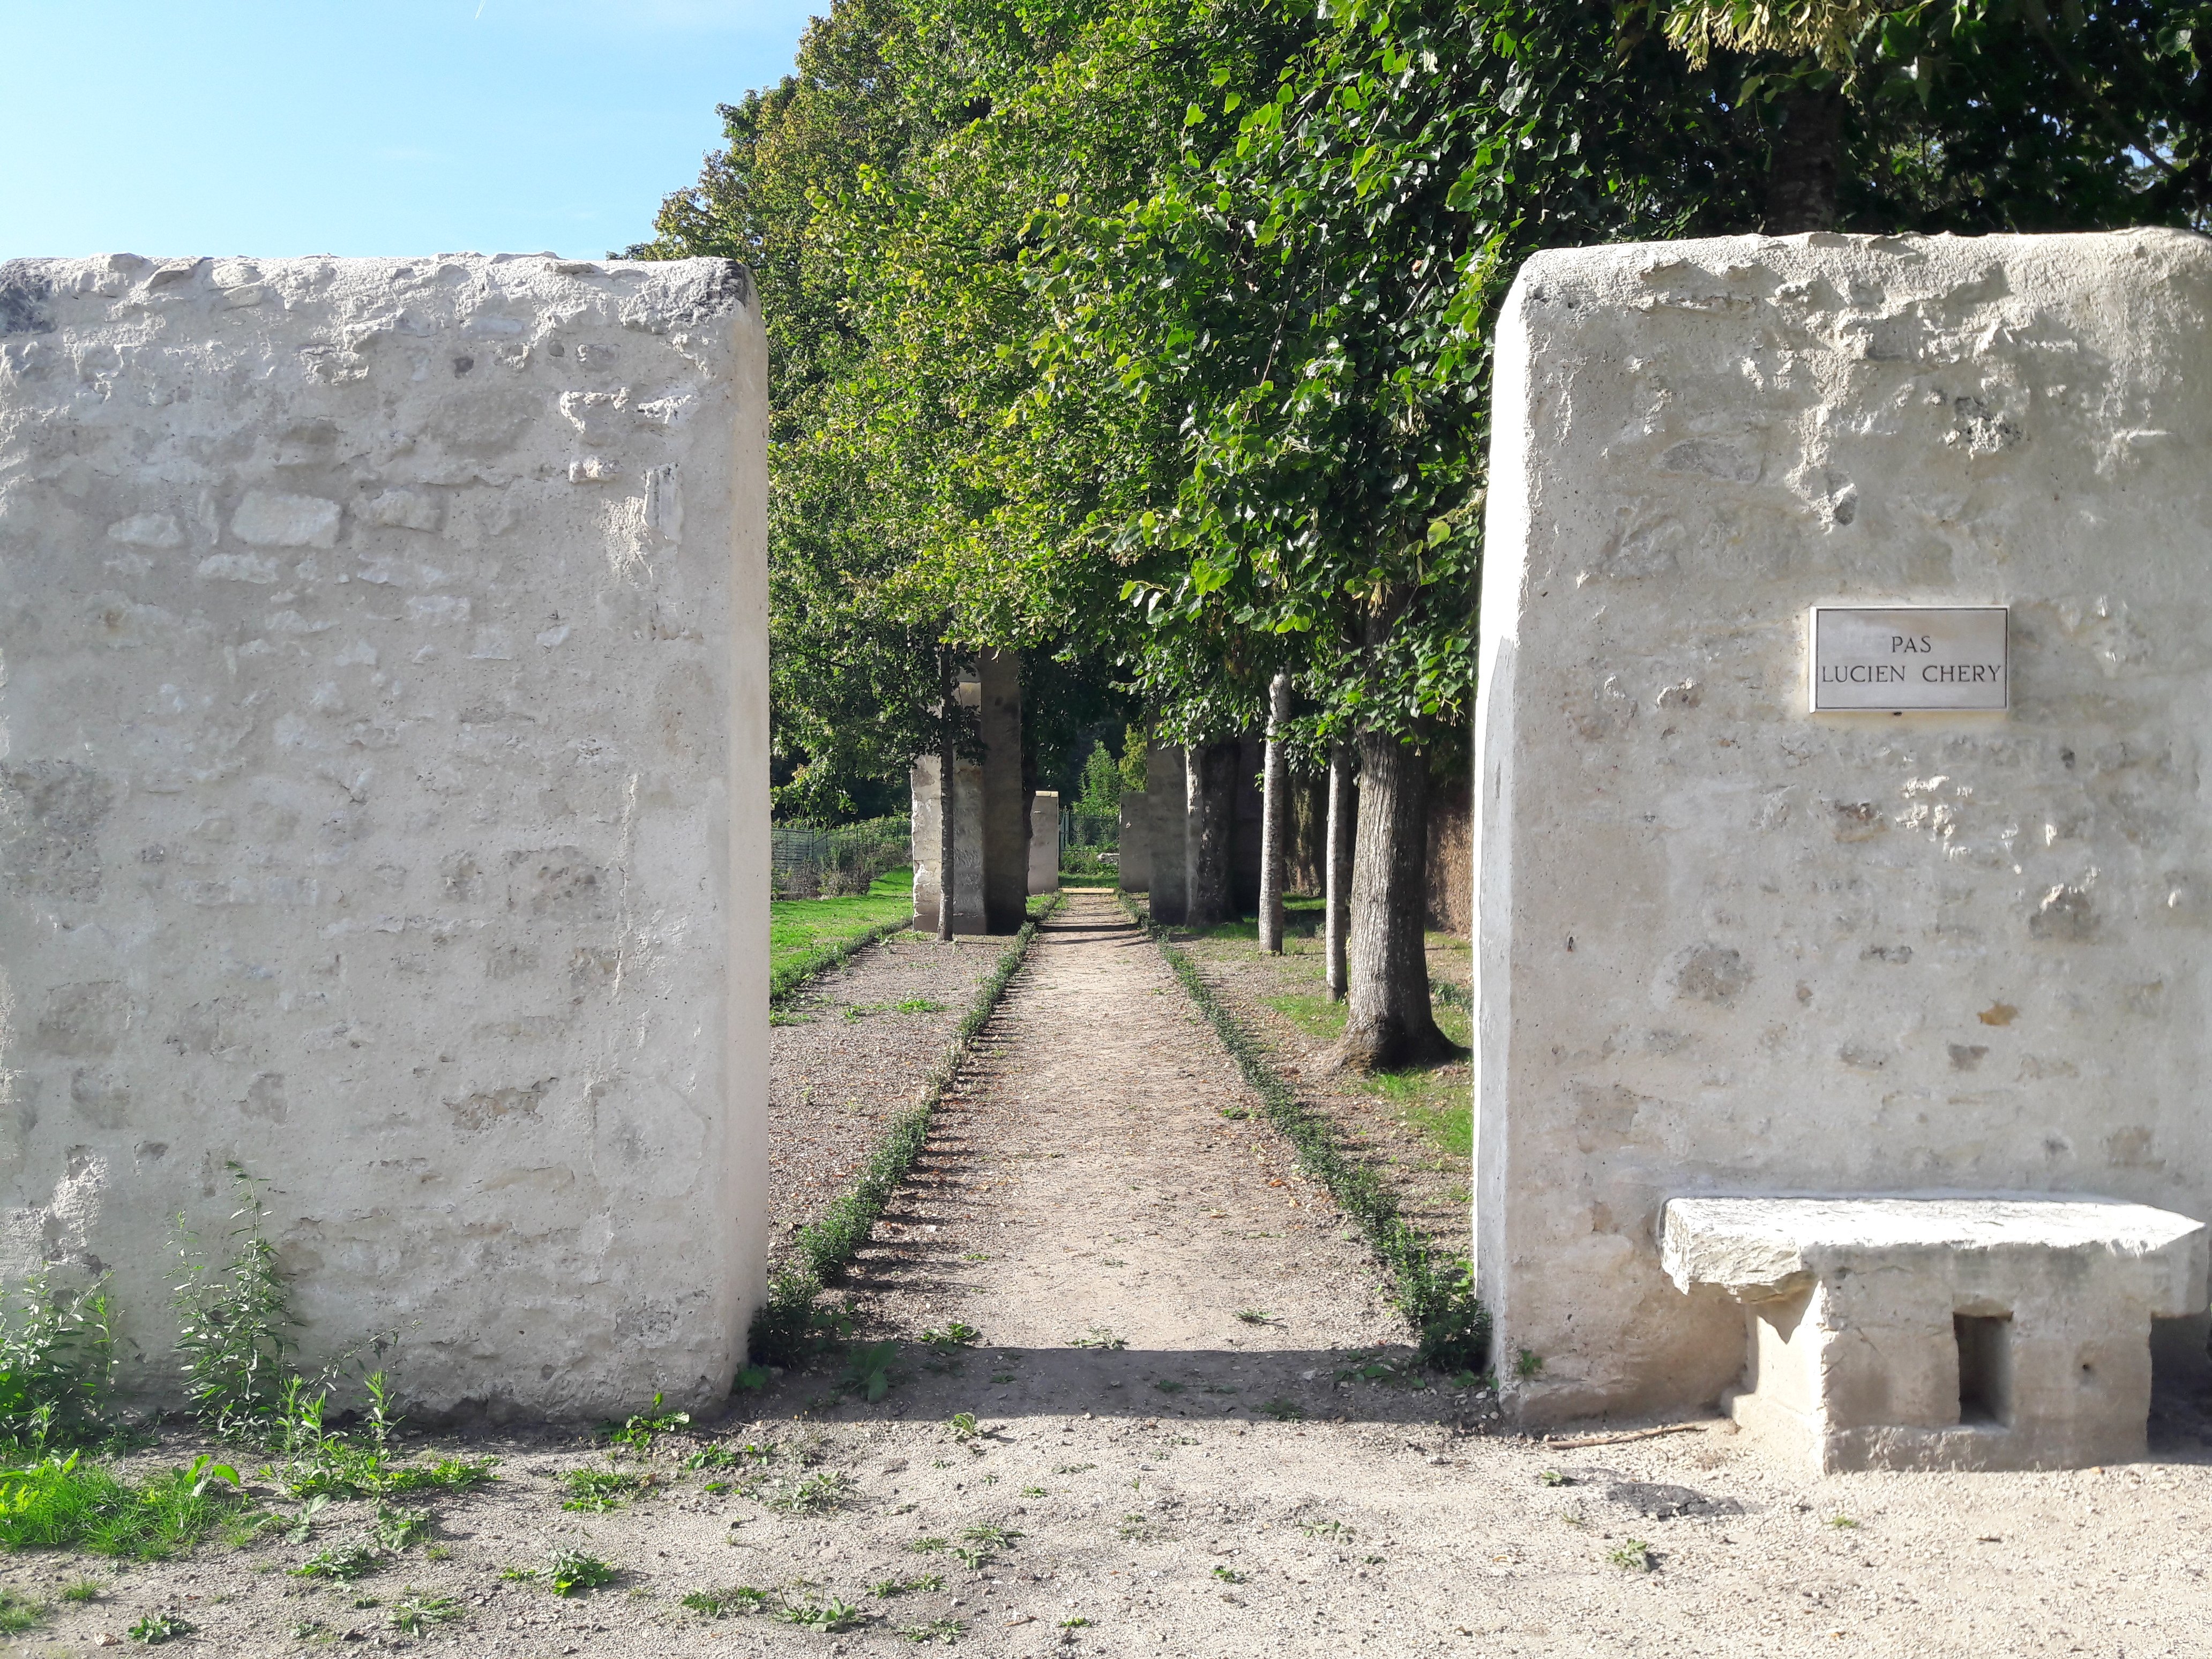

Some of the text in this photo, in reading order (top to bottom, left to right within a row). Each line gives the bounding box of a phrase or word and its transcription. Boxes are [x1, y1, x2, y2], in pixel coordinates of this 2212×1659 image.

[1892, 636, 1932, 653] PAS
[1822, 665, 2001, 683] LUCIEN CHERY
